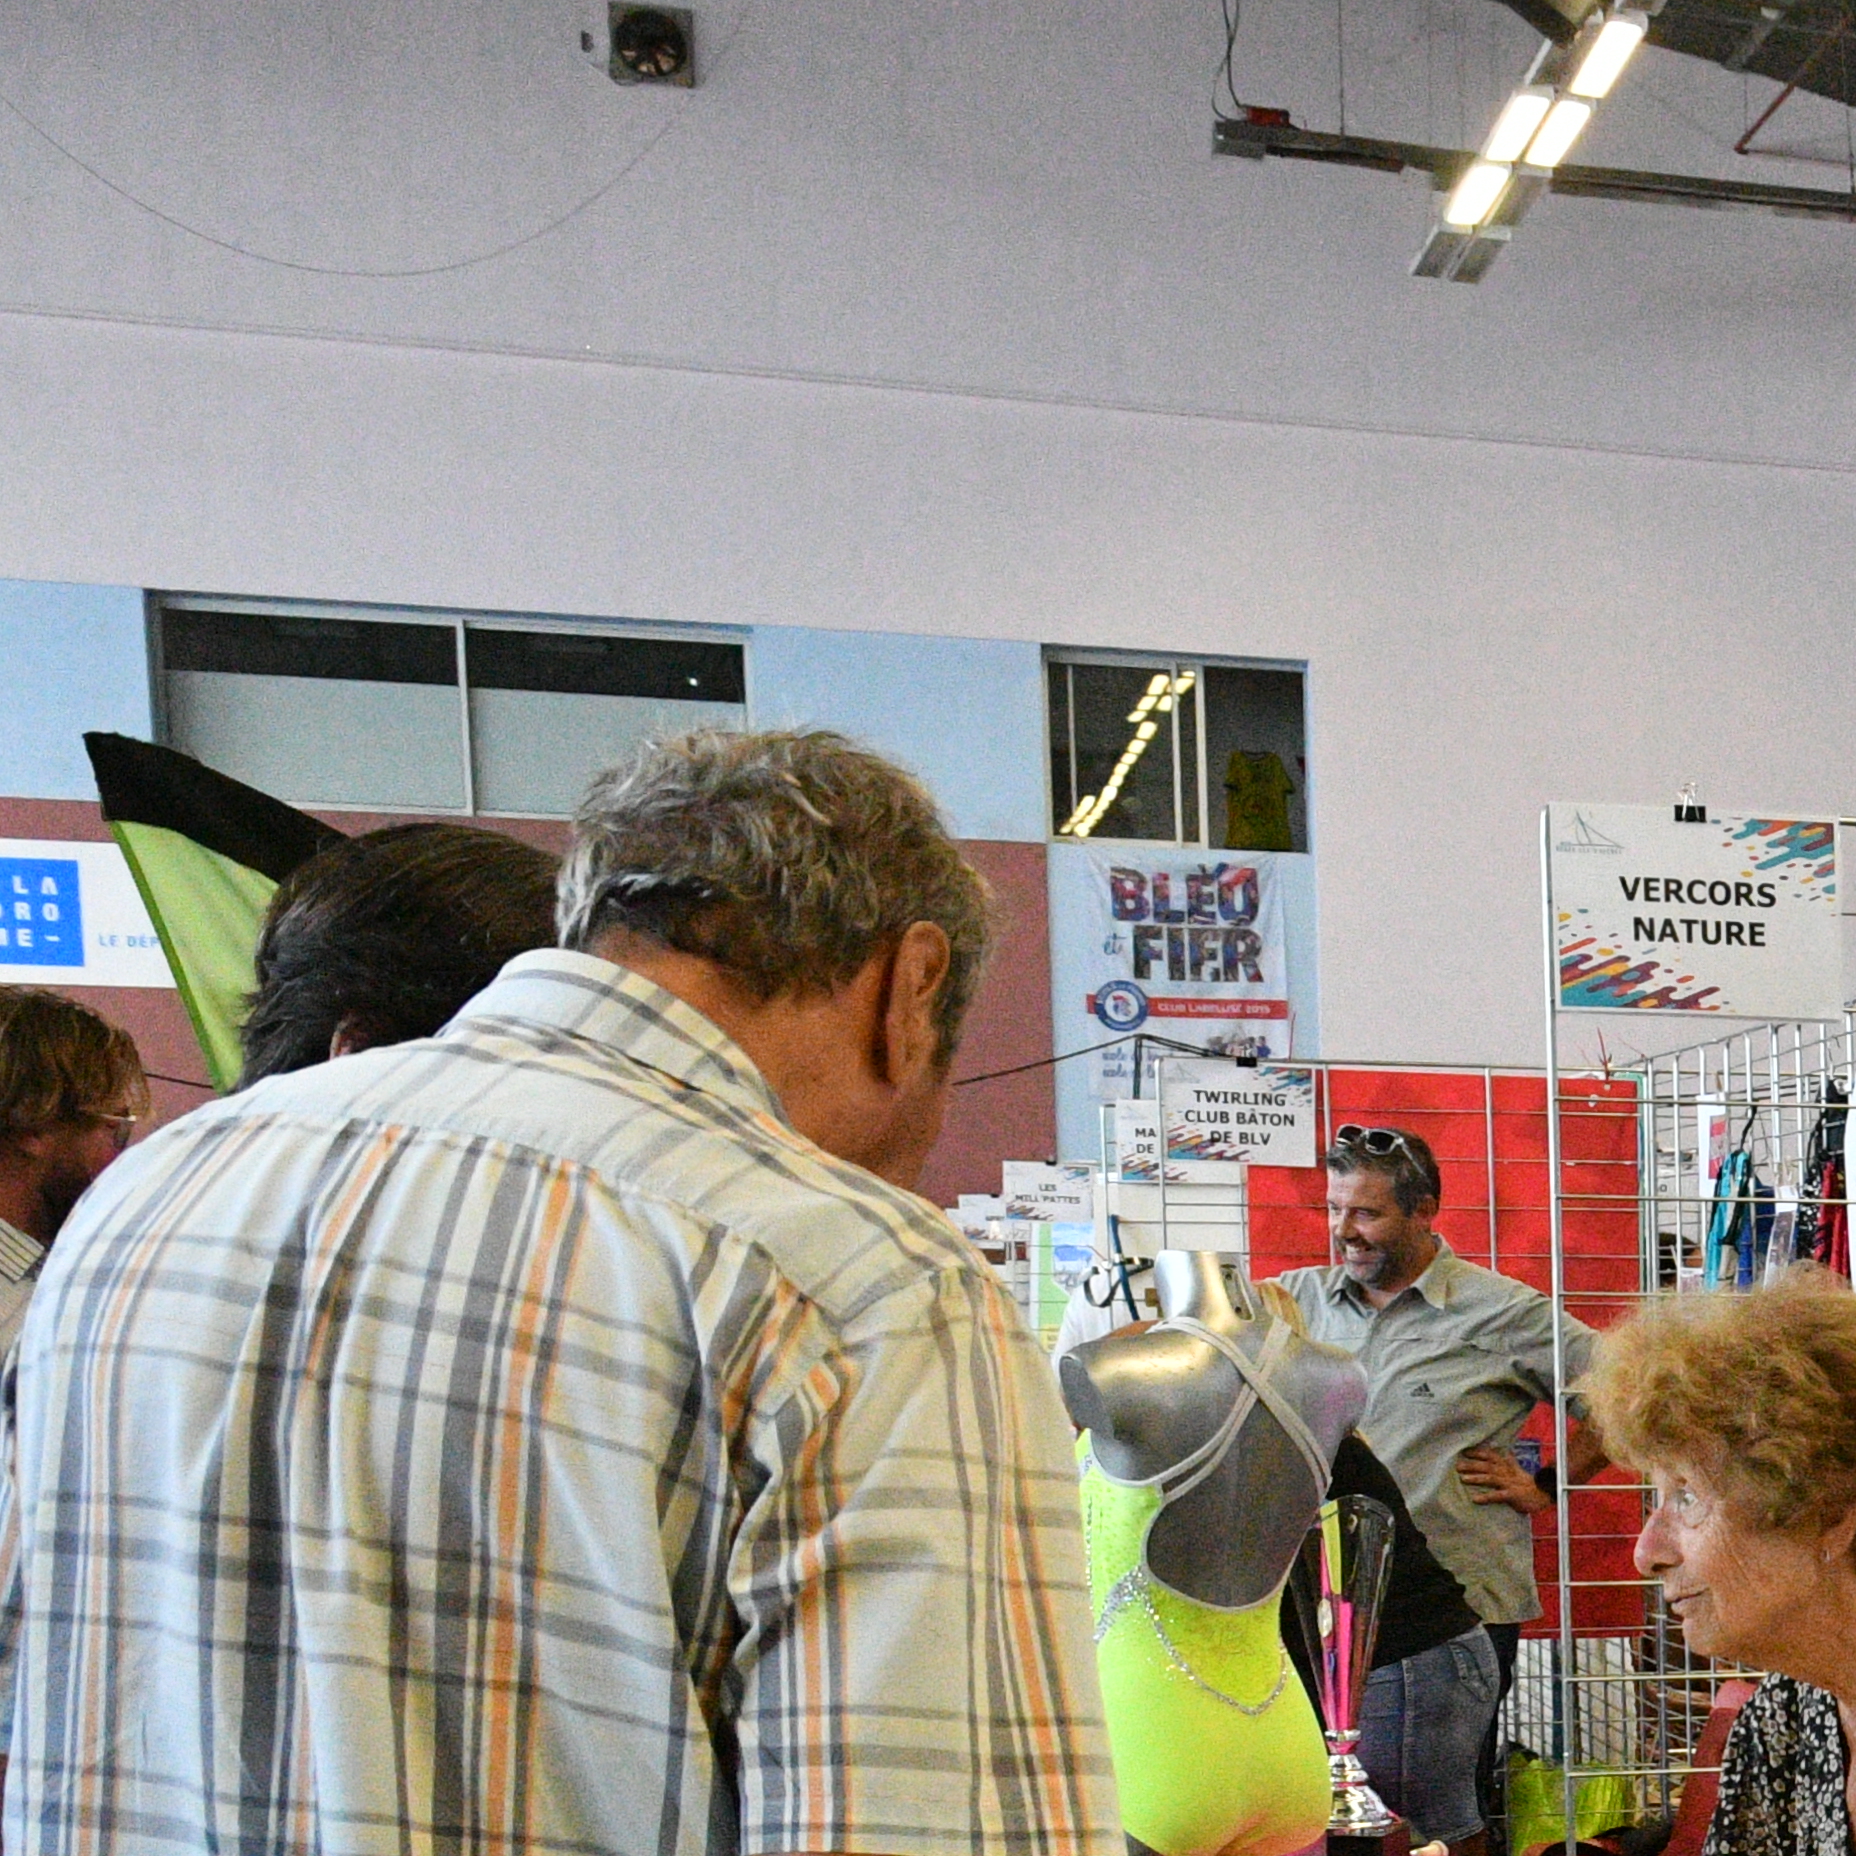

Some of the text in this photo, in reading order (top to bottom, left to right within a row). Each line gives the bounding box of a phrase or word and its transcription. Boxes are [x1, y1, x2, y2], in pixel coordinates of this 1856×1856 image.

[12, 875, 58, 895] LA
[1618, 876, 1777, 908] VERCORS
[0, 901, 60, 921] RO
[127, 933, 161, 948] DÉP
[1633, 917, 1766, 947] NATURE
[1133, 925, 1264, 983] FIER
[1193, 1089, 1287, 1107] TWIRLING
[1184, 1109, 1230, 1124] CLUB
[1135, 1128, 1157, 1138] MA
[1210, 1130, 1272, 1146] DE BLV
[1038, 1183, 1057, 1192] LES
